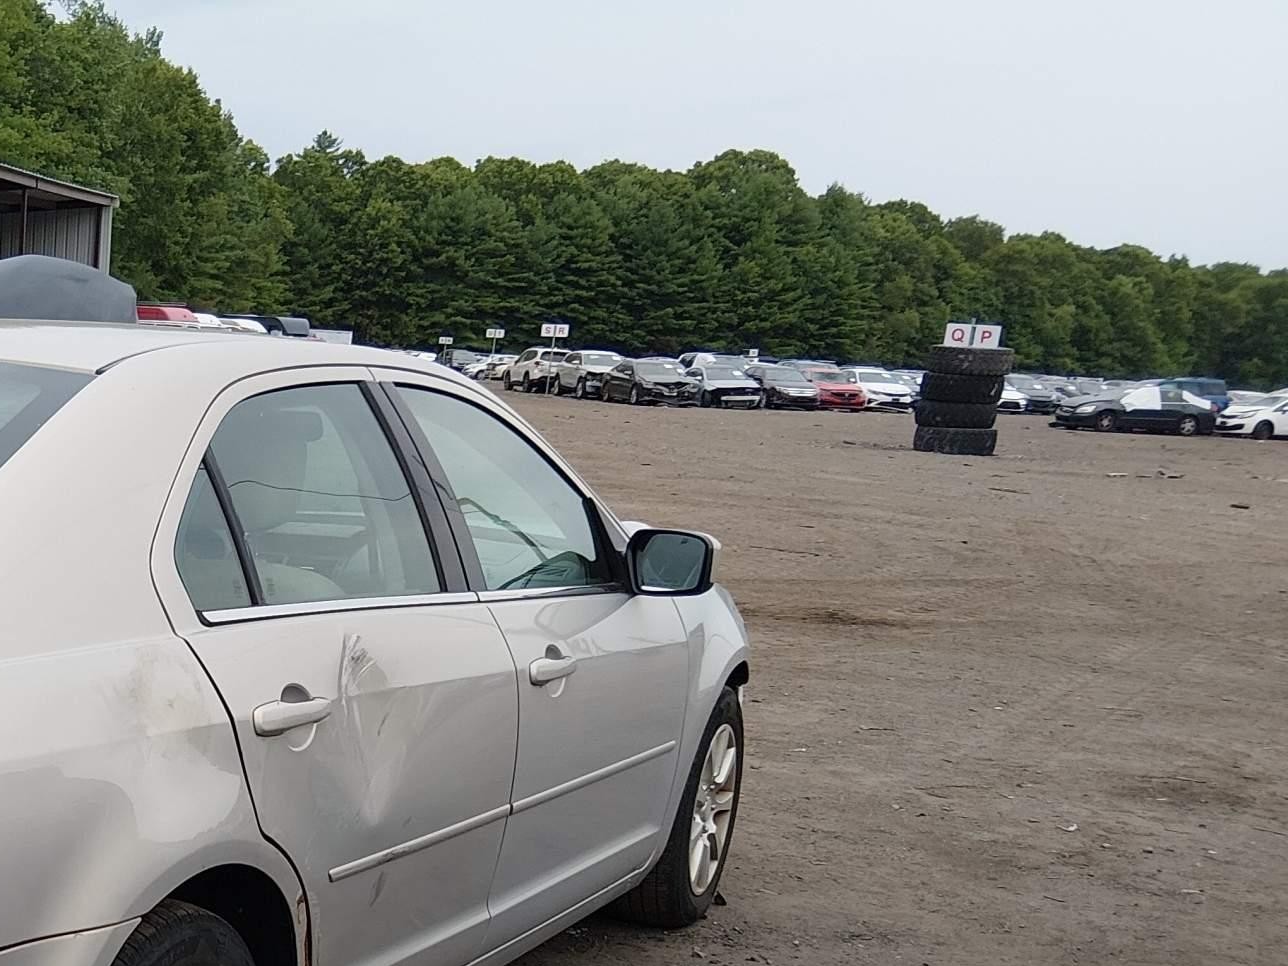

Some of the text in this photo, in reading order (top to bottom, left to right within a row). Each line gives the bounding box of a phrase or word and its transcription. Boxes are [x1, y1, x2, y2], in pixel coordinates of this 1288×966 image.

[544, 326, 566, 335] S R
[951, 328, 992, 343] Q P
